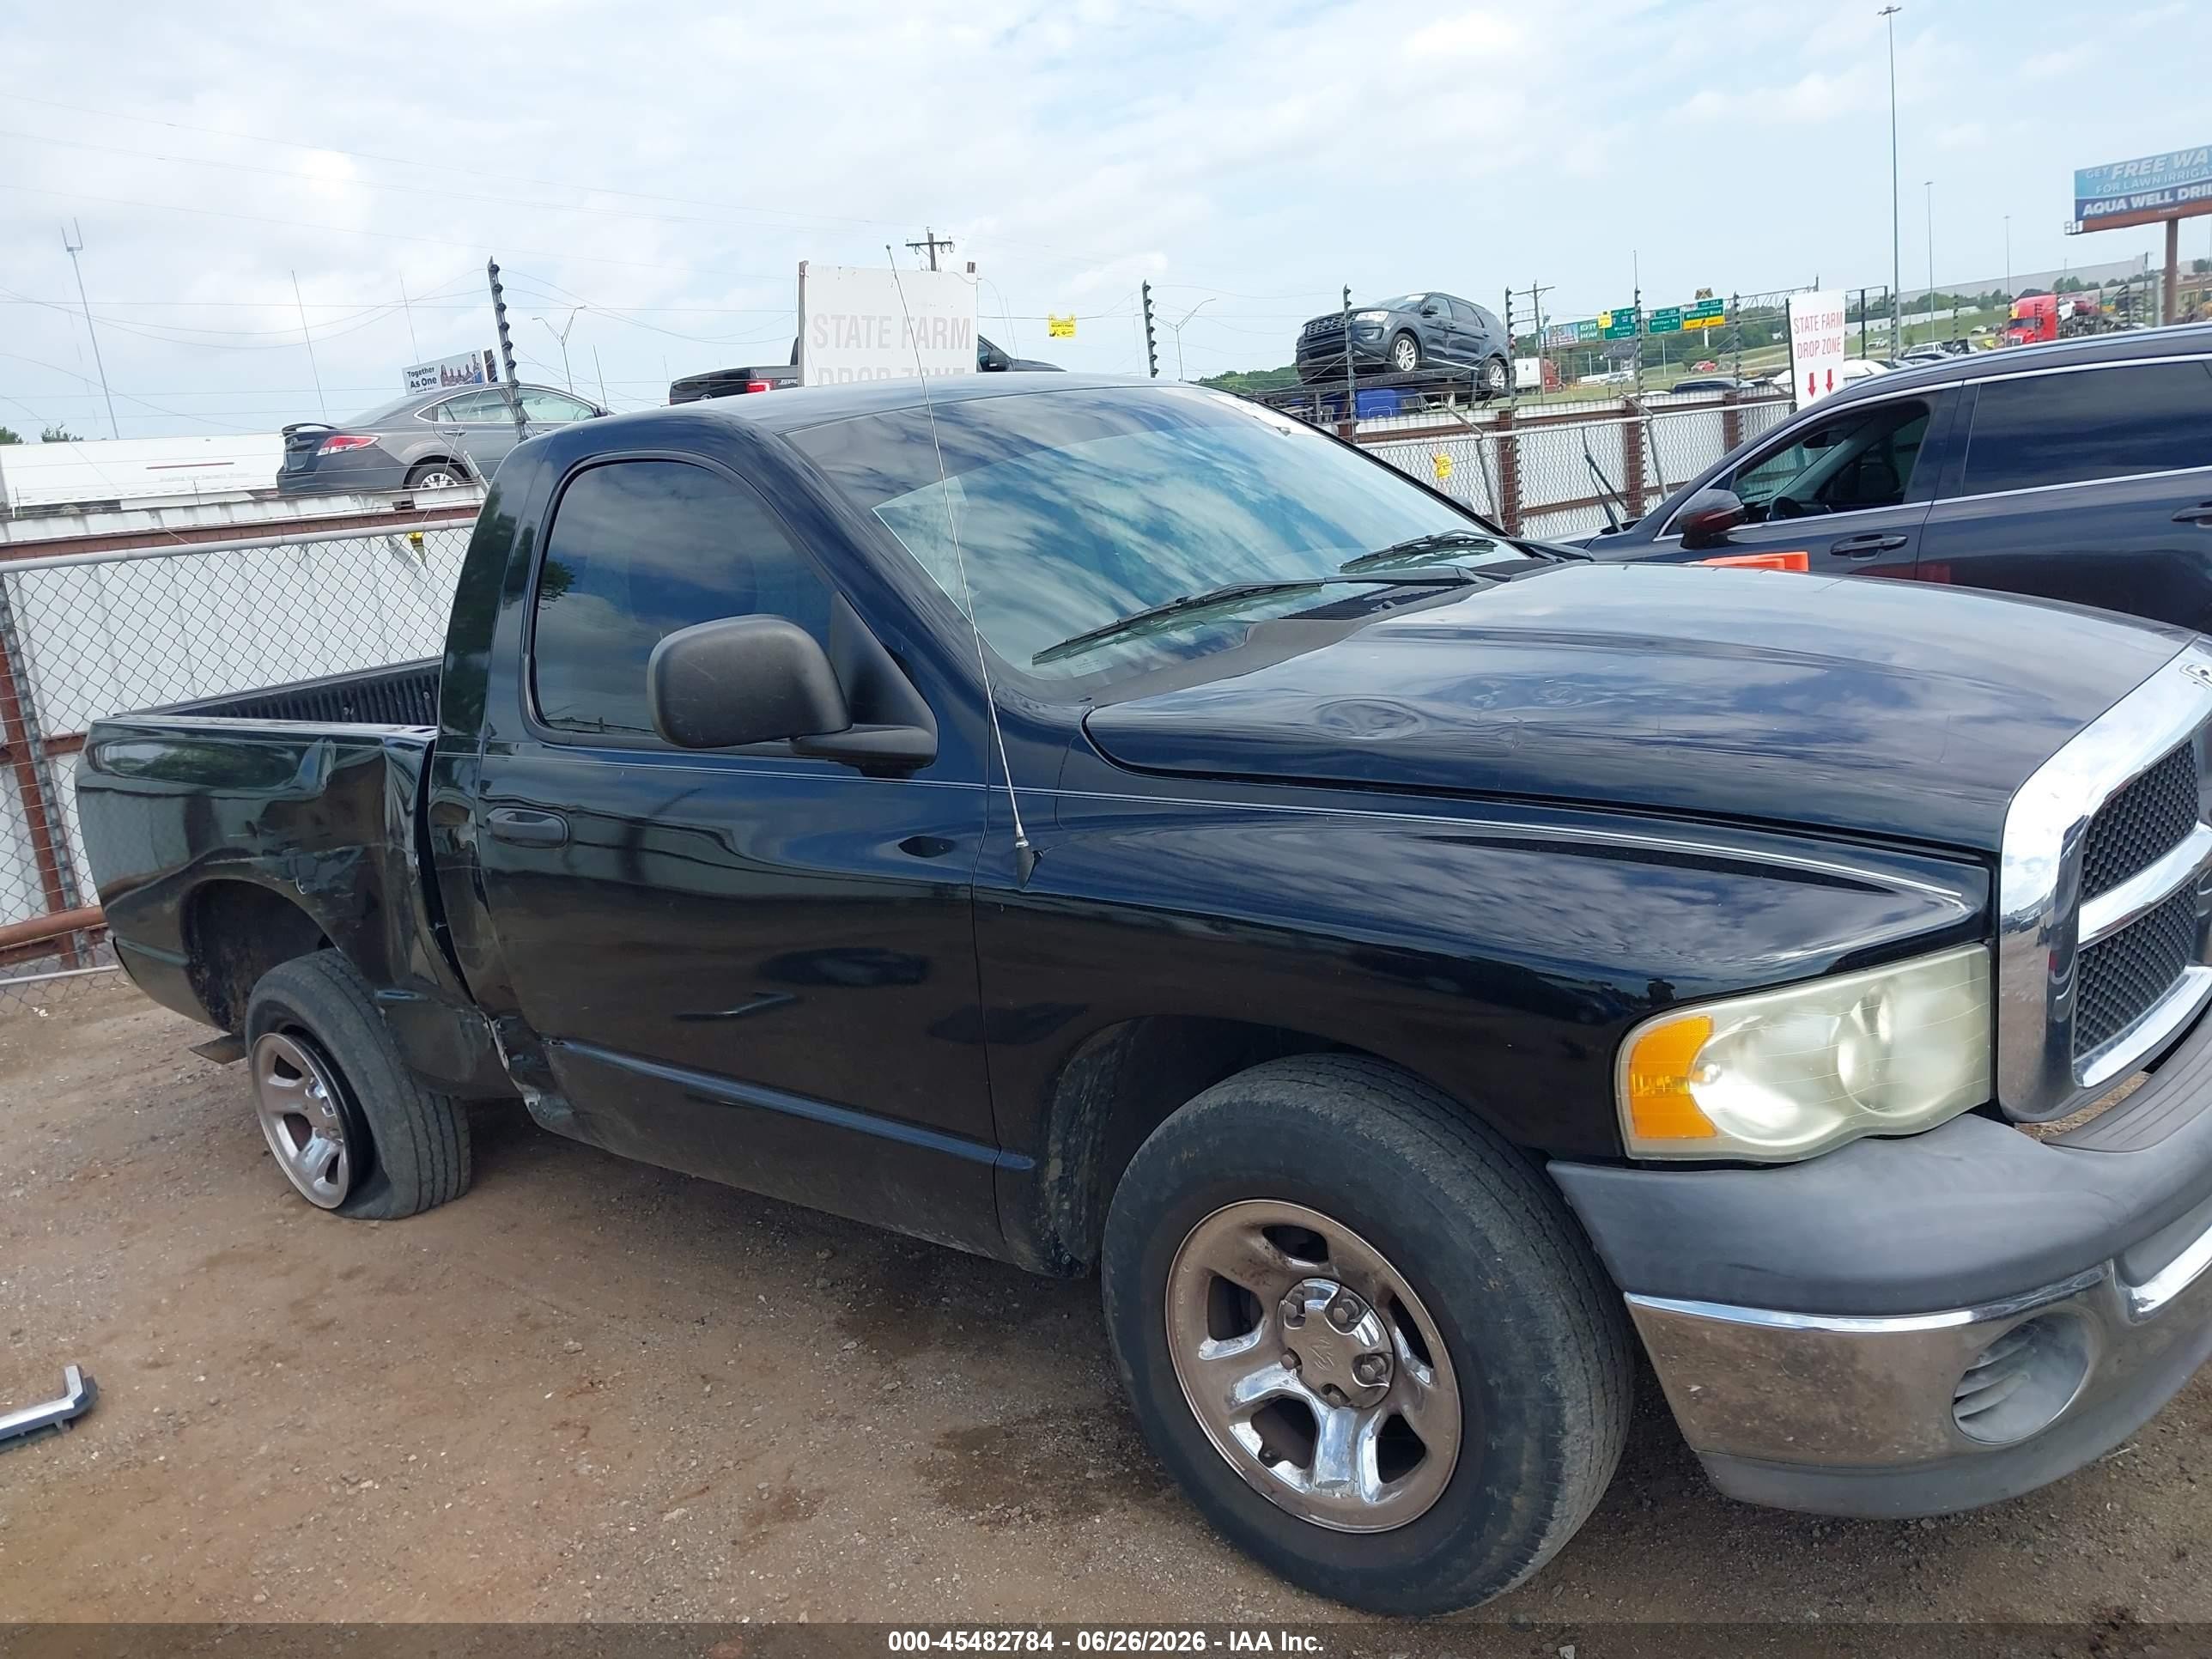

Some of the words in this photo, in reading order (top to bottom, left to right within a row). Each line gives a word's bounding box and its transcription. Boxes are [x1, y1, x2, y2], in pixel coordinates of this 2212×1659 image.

[2086, 167, 2109, 179] GET
[2112, 156, 2166, 179] FREE
[2096, 182, 2119, 194] FOR
[2124, 176, 2160, 190] LAWN
[2164, 165, 2212, 181] IRRIGA
[2083, 198, 2127, 216] AQUA
[2130, 190, 2173, 208] WELL
[812, 313, 893, 349] STATE
[901, 315, 970, 350] FARM
[1794, 315, 1819, 335] STATE
[1821, 311, 1843, 331] FARM
[1797, 340, 1820, 359] DROP
[1821, 336, 1841, 355] ZONE
[406, 368, 434, 378] Together
[410, 380, 421, 389] As
[421, 376, 437, 386] One
